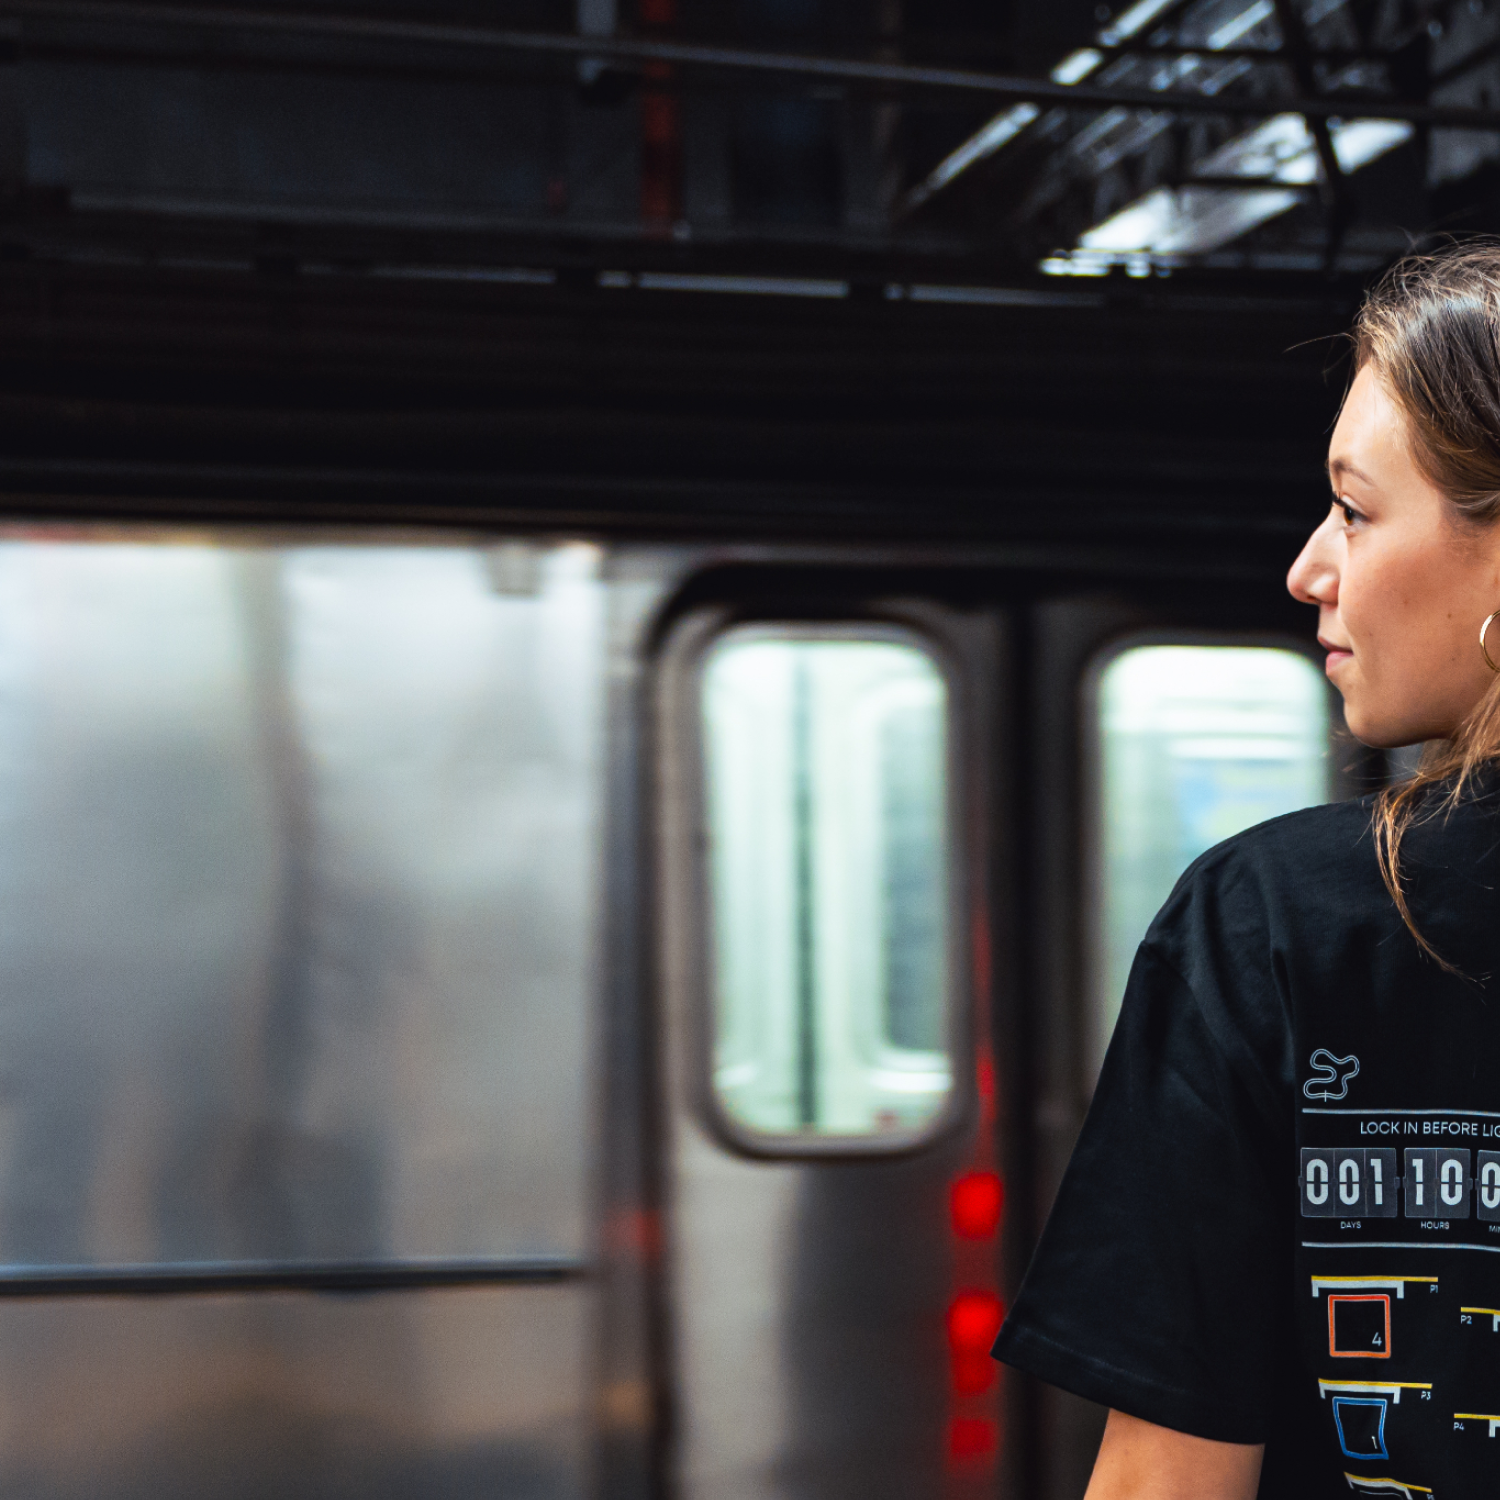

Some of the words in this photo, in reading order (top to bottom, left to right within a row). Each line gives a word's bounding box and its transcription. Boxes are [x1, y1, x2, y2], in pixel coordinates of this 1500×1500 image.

[1360, 1121, 1400, 1136] LOCK
[1404, 1122, 1418, 1135] IN
[1423, 1122, 1478, 1137] BEFORE
[1306, 1158, 1383, 1206] 001
[1412, 1158, 1464, 1206] 10
[1340, 1221, 1362, 1230] DAYS
[1420, 1221, 1450, 1231] HOURS
[1430, 1284, 1438, 1293] P1
[1460, 1315, 1472, 1325] P2
[1371, 1332, 1382, 1346] 4
[1421, 1390, 1431, 1400] P3
[1453, 1422, 1464, 1431] P4
